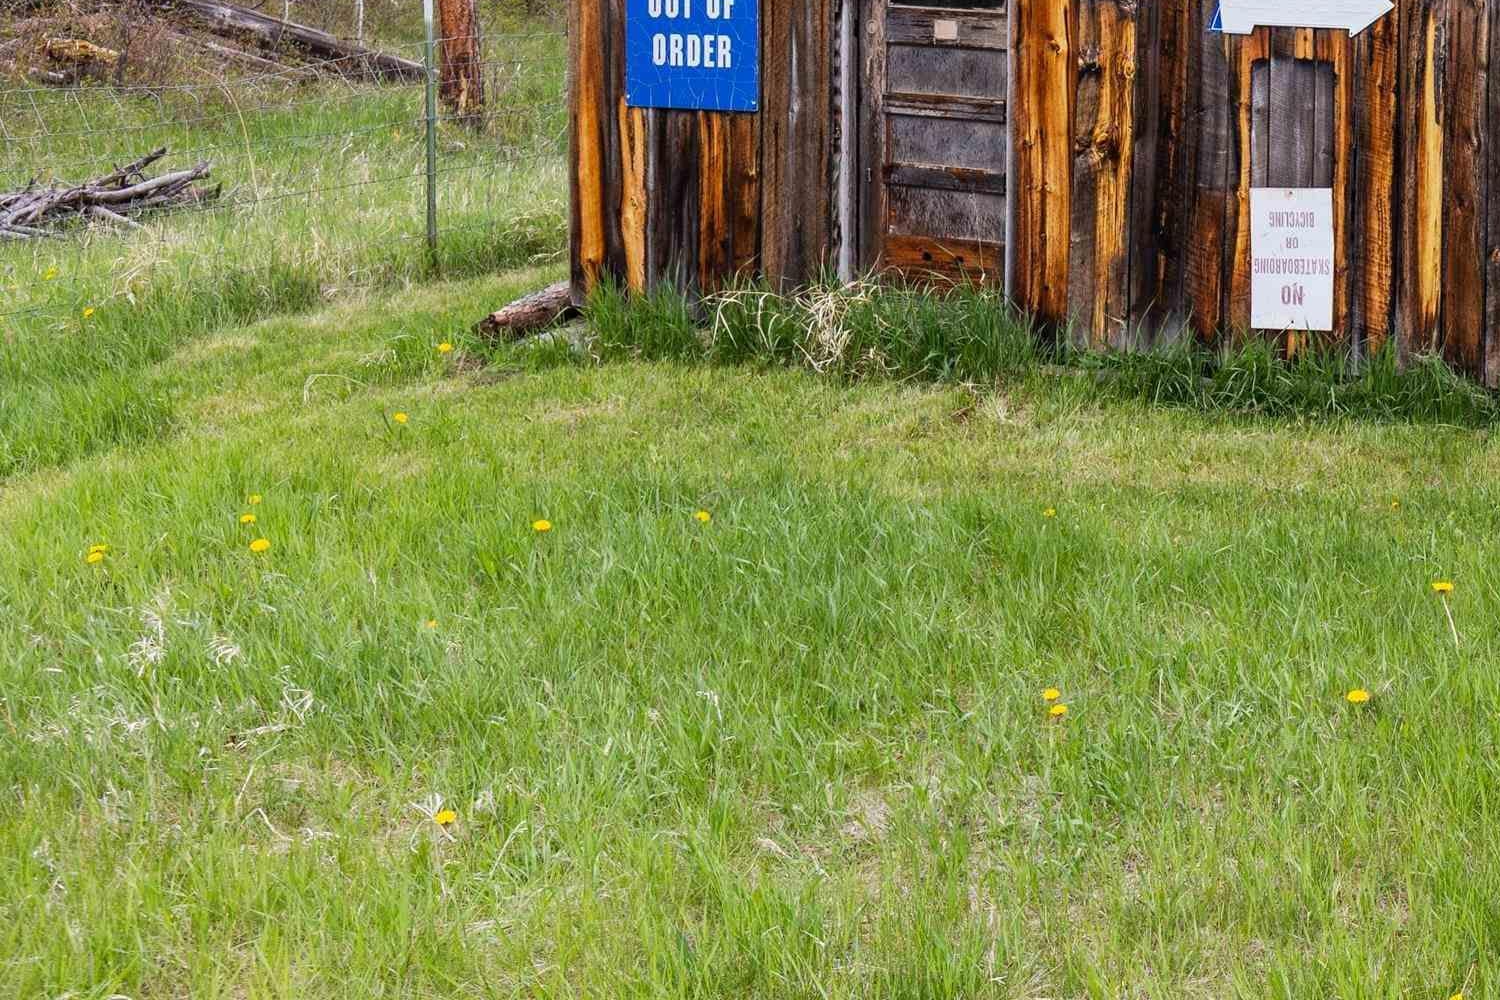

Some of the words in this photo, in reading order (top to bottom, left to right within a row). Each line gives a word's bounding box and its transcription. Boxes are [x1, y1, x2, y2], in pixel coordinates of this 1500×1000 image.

[652, 33, 732, 68] ORDER
[1268, 211, 1315, 228] BICYCLING
[1286, 236, 1299, 249] OR
[1254, 257, 1330, 275] SKATEBOARDING
[1281, 285, 1304, 306] NO
